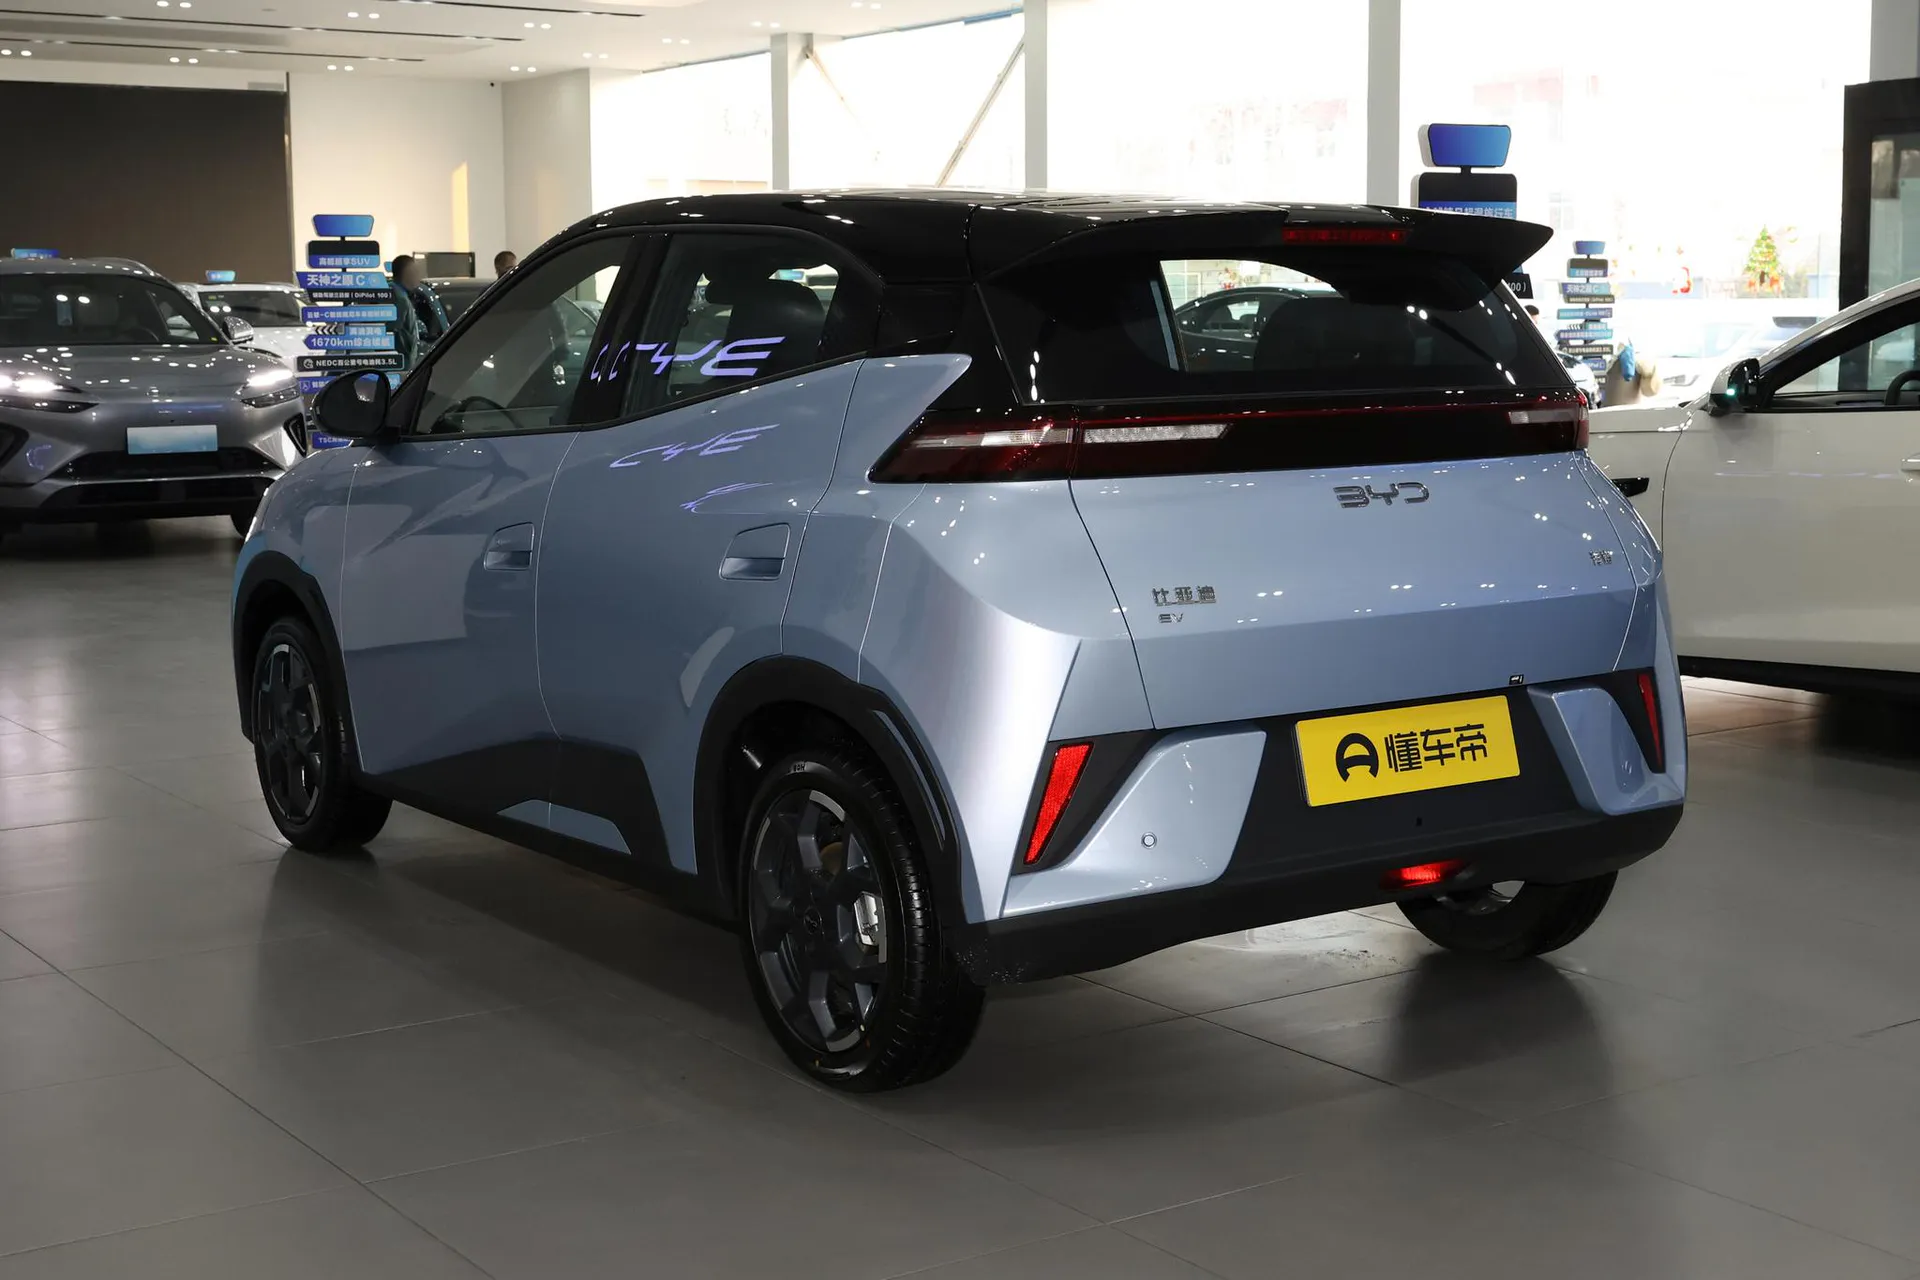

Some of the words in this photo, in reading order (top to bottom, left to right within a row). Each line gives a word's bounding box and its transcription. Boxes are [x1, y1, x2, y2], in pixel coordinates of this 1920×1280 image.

[307, 274, 354, 286] 天神之眼
[356, 275, 366, 286] C
[1333, 481, 1430, 509] BYD
[1151, 585, 1217, 607] 比亚迪
[1158, 612, 1184, 624] EV
[1384, 723, 1488, 773] 懂车帝
